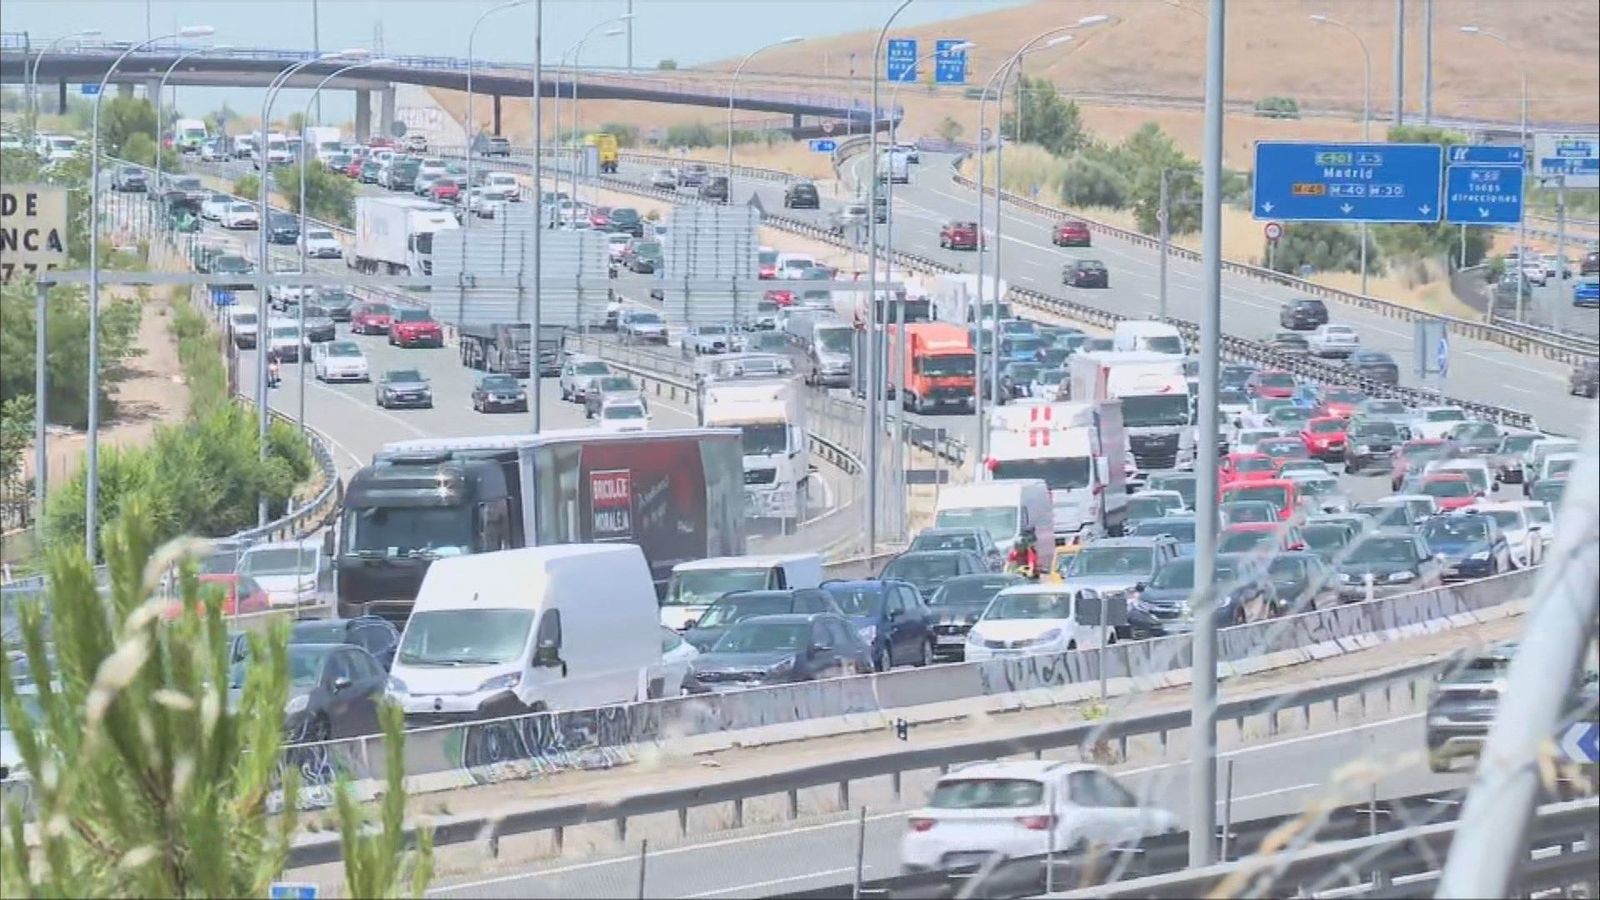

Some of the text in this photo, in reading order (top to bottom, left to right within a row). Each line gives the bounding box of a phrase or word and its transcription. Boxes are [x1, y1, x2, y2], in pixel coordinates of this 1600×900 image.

[1323, 167, 1373, 179] Madrid
[1331, 185, 1364, 195] M-40
[1370, 186, 1402, 195] M-30
[1468, 183, 1501, 192] Todos
[1451, 193, 1518, 203] direcciones
[2, 193, 38, 216] DE
